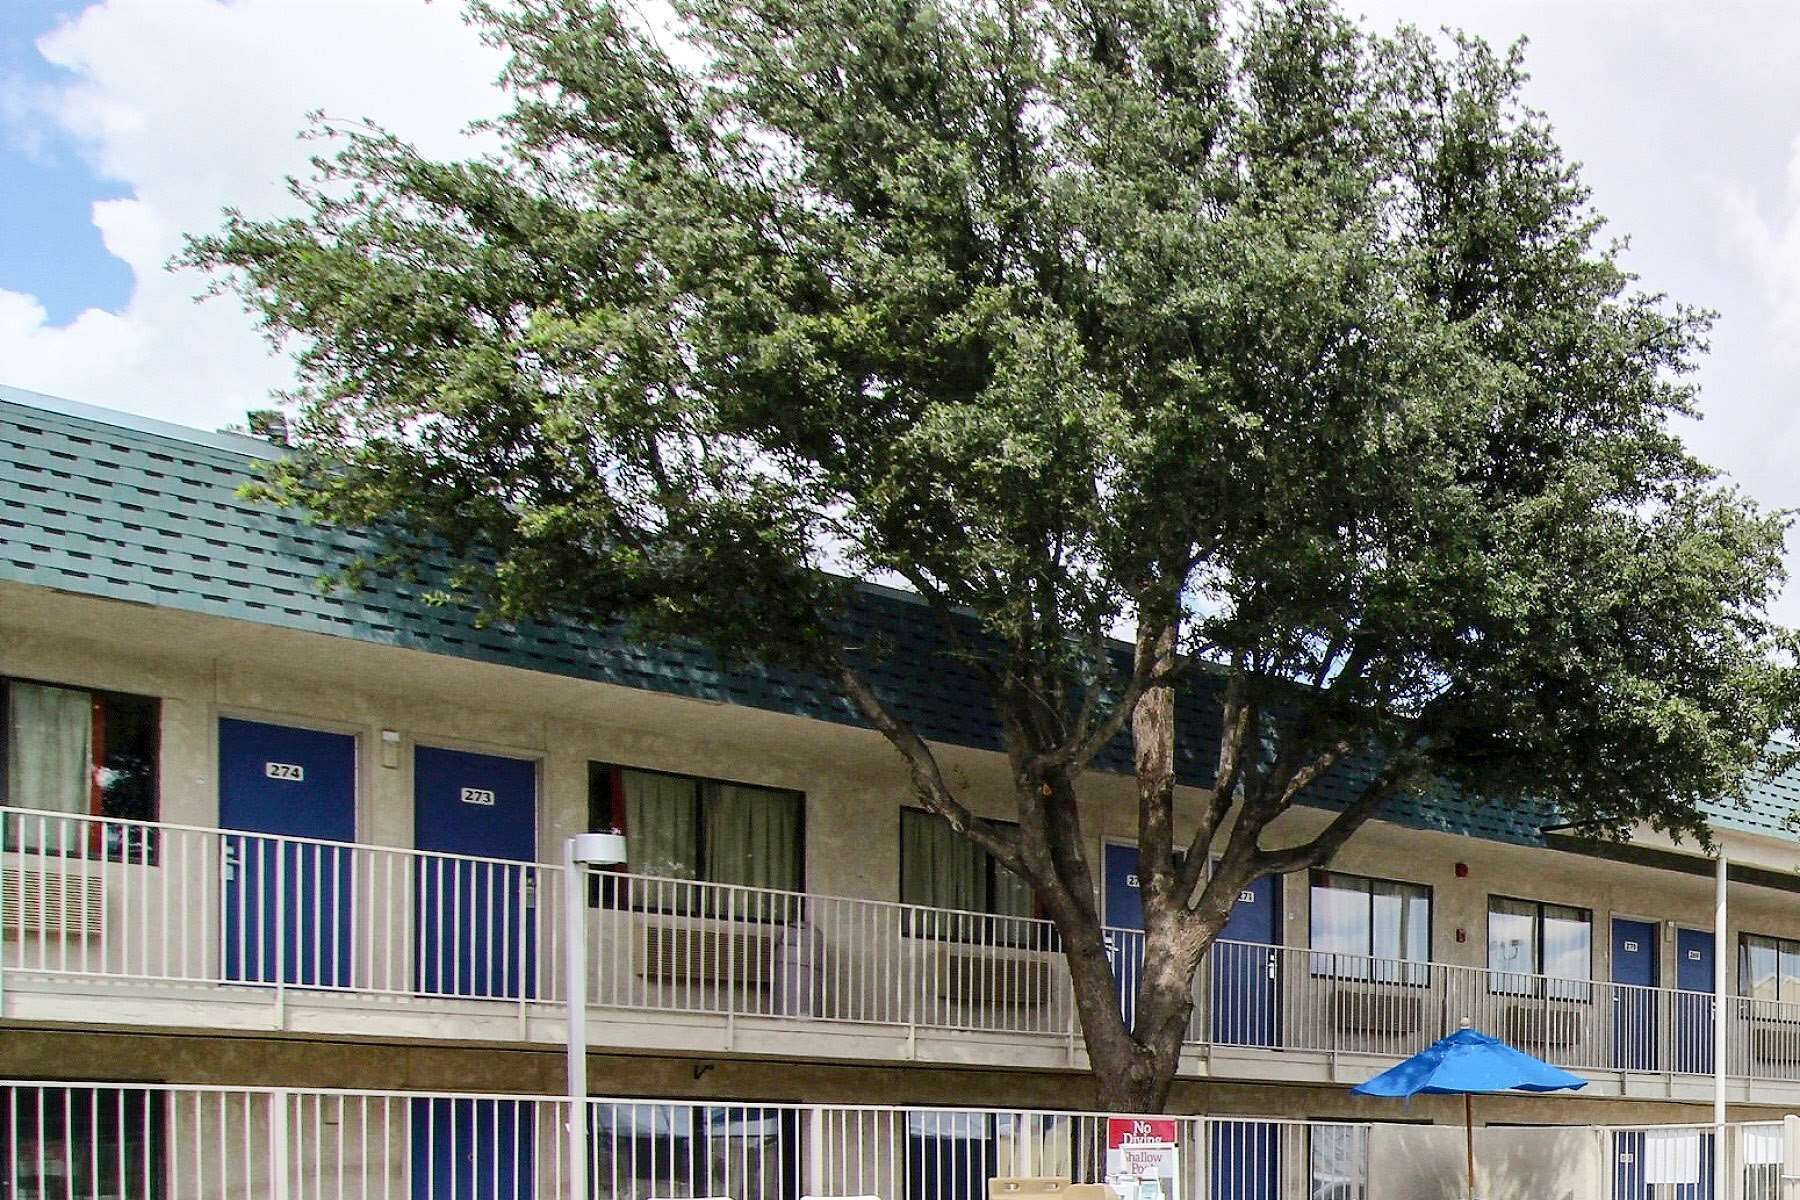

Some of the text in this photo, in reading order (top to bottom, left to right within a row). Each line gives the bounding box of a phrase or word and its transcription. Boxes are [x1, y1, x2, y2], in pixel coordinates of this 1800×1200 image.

[270, 764, 300, 778] 274
[464, 790, 491, 803] 273
[1132, 1120, 1152, 1134] No
